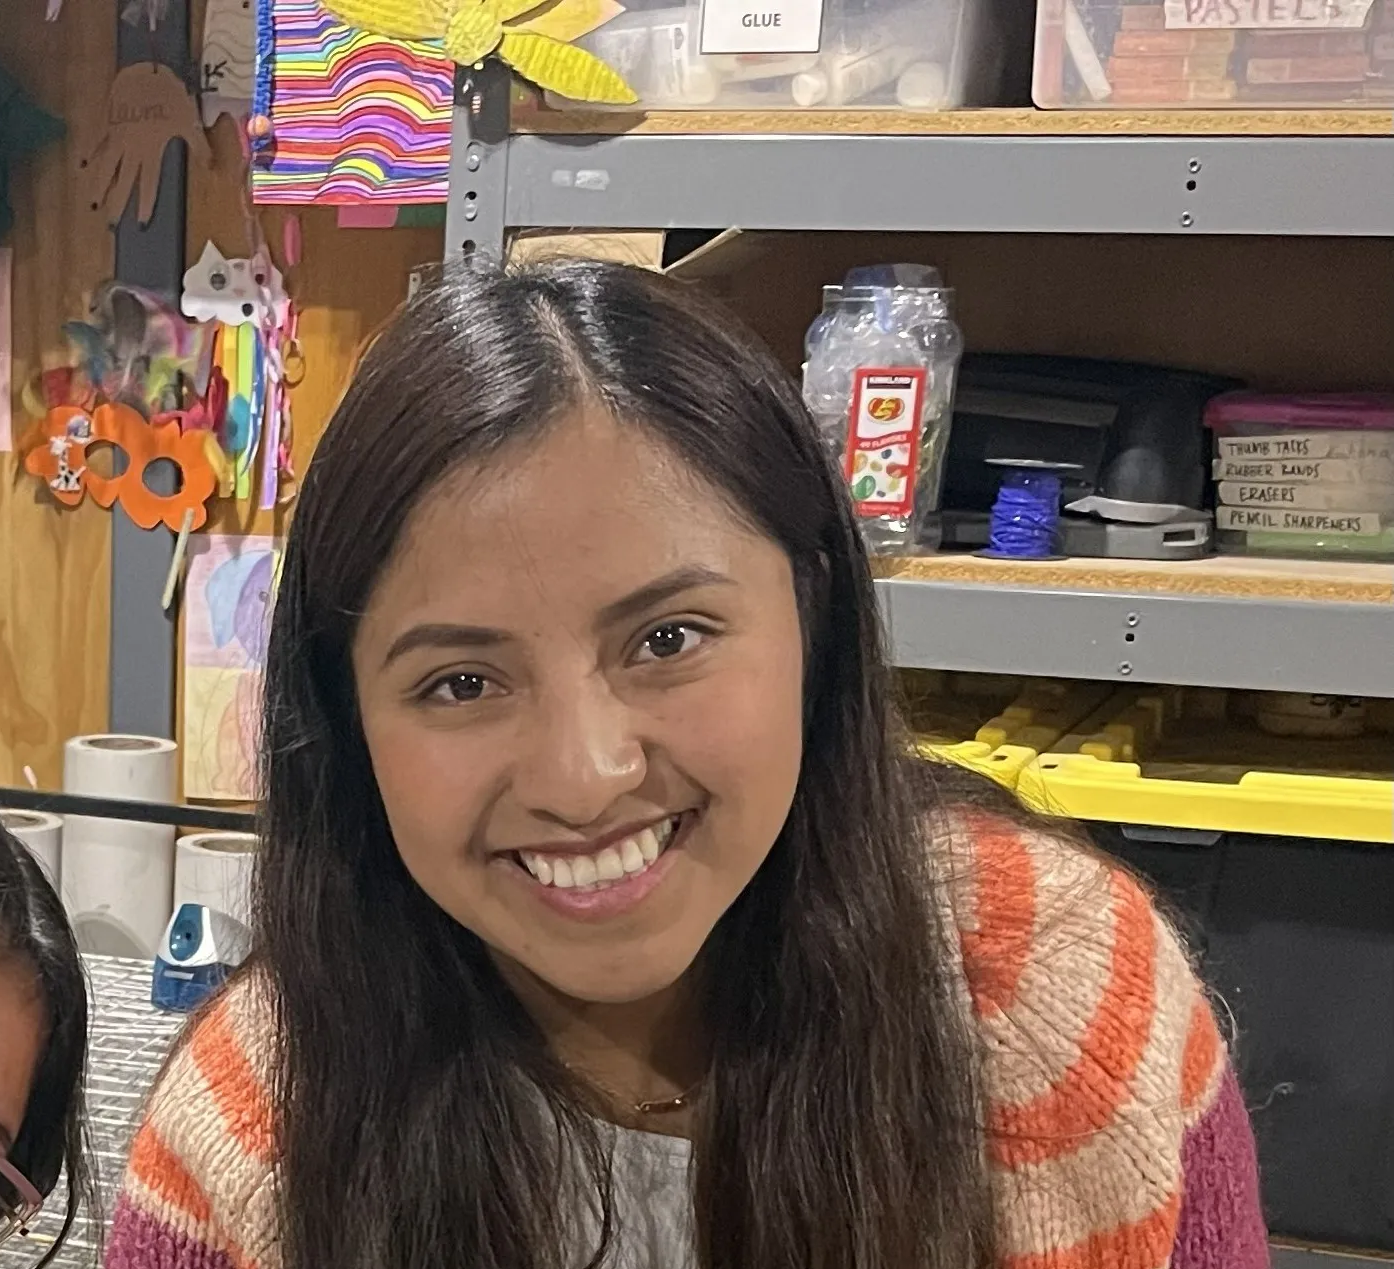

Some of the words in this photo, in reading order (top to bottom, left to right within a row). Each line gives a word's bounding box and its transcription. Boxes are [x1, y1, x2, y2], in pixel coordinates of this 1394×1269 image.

[742, 13, 782, 28] GLUE
[1226, 441, 1270, 456] THUMB
[1225, 463, 1274, 477] RUBBER
[1281, 463, 1321, 478] BANDS
[1239, 487, 1297, 502] ERASERS
[1229, 510, 1278, 527] PENCIL
[1283, 513, 1363, 532] SHARPENERS
